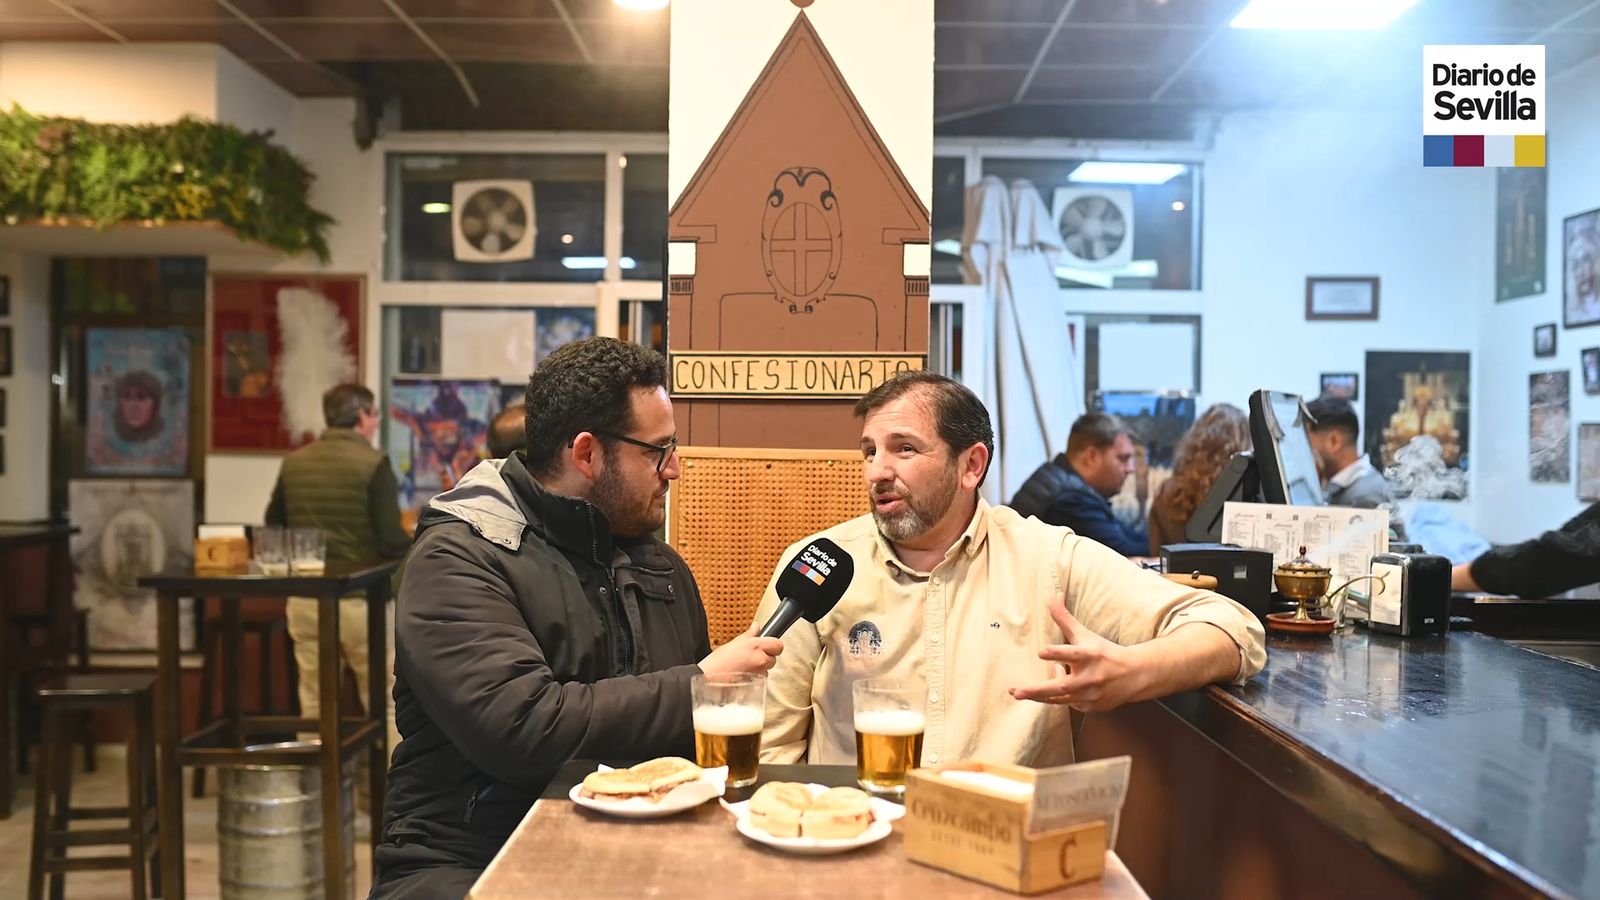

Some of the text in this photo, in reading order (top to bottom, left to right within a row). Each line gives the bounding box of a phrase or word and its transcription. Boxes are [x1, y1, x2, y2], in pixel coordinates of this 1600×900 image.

[800, 551, 831, 576] Sevilla
[808, 544, 838, 568] Diario de
[1058, 836, 1078, 881] C
